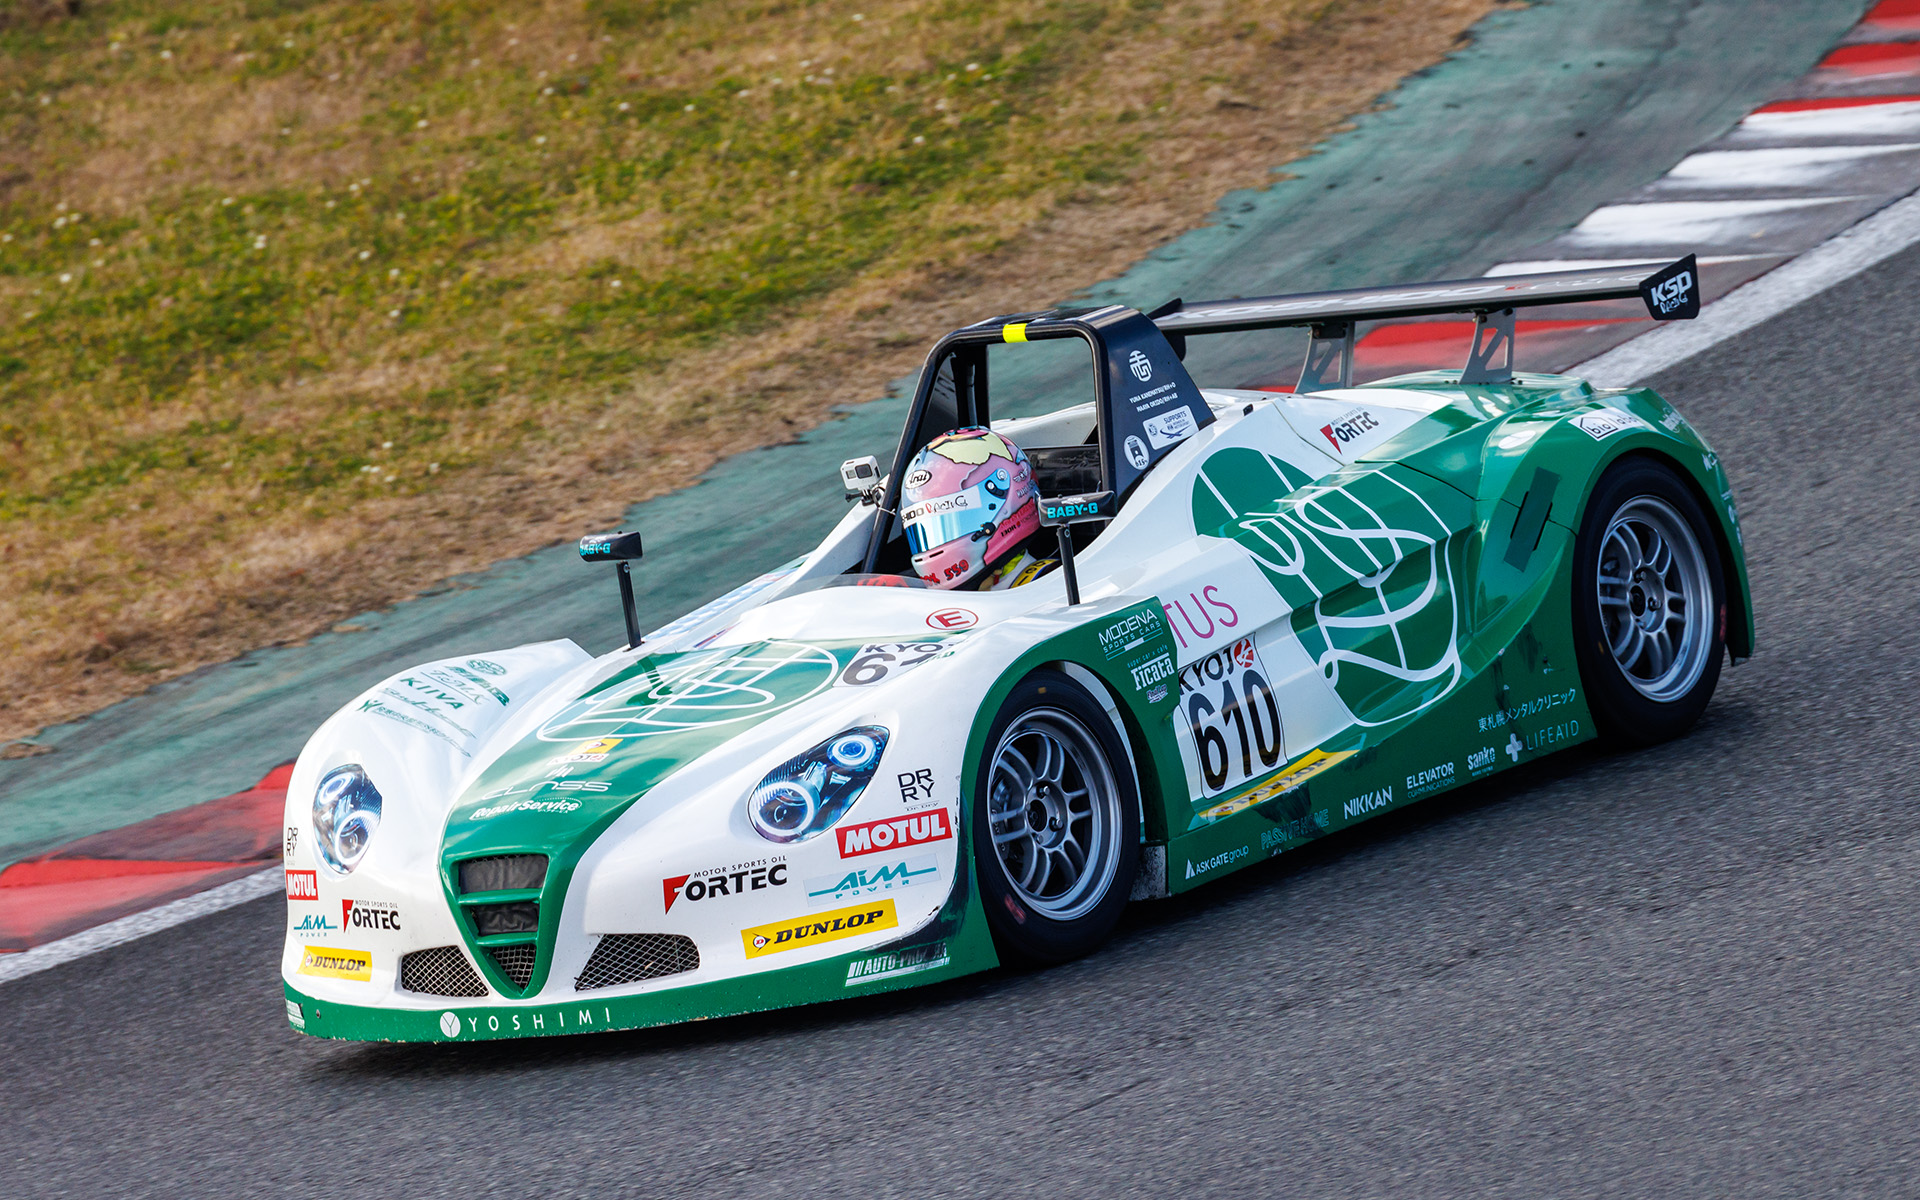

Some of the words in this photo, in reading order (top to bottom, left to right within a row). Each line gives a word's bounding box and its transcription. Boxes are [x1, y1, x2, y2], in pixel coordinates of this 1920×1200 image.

[1320, 411, 1379, 455] FORTEC
[1047, 502, 1098, 519] BABY-G
[579, 542, 611, 556] BABY-G
[944, 559, 969, 581] 559
[934, 610, 970, 628] E
[1098, 609, 1158, 645] MODENA
[1103, 633, 1136, 653] SPORTS
[1139, 620, 1161, 635] CARS
[1131, 658, 1175, 691] Ficata
[400, 677, 465, 710] KIIVA
[1188, 669, 1282, 791] 610
[1526, 720, 1579, 750] LIFEAID
[1467, 746, 1496, 771] sanko
[1406, 762, 1455, 790] ELEVATOR
[1407, 776, 1455, 799] COMMUNICATIONS
[1343, 786, 1393, 820] NIKKAN
[844, 814, 946, 854] MOTUL
[694, 867, 727, 878] MOTOR
[732, 859, 767, 871] SPORTS
[771, 855, 787, 863] OIL
[1196, 859, 1210, 875] ASK
[1210, 852, 1229, 869] GATE
[1228, 845, 1249, 863] group
[287, 874, 317, 896] MOTUL
[663, 864, 788, 915] FORTEC
[836, 879, 909, 899] POWER
[342, 899, 401, 933] FORTEC
[774, 909, 883, 945] DUNLOP
[313, 957, 366, 971] DUNLOP
[468, 1007, 610, 1032] YOSHIMI
